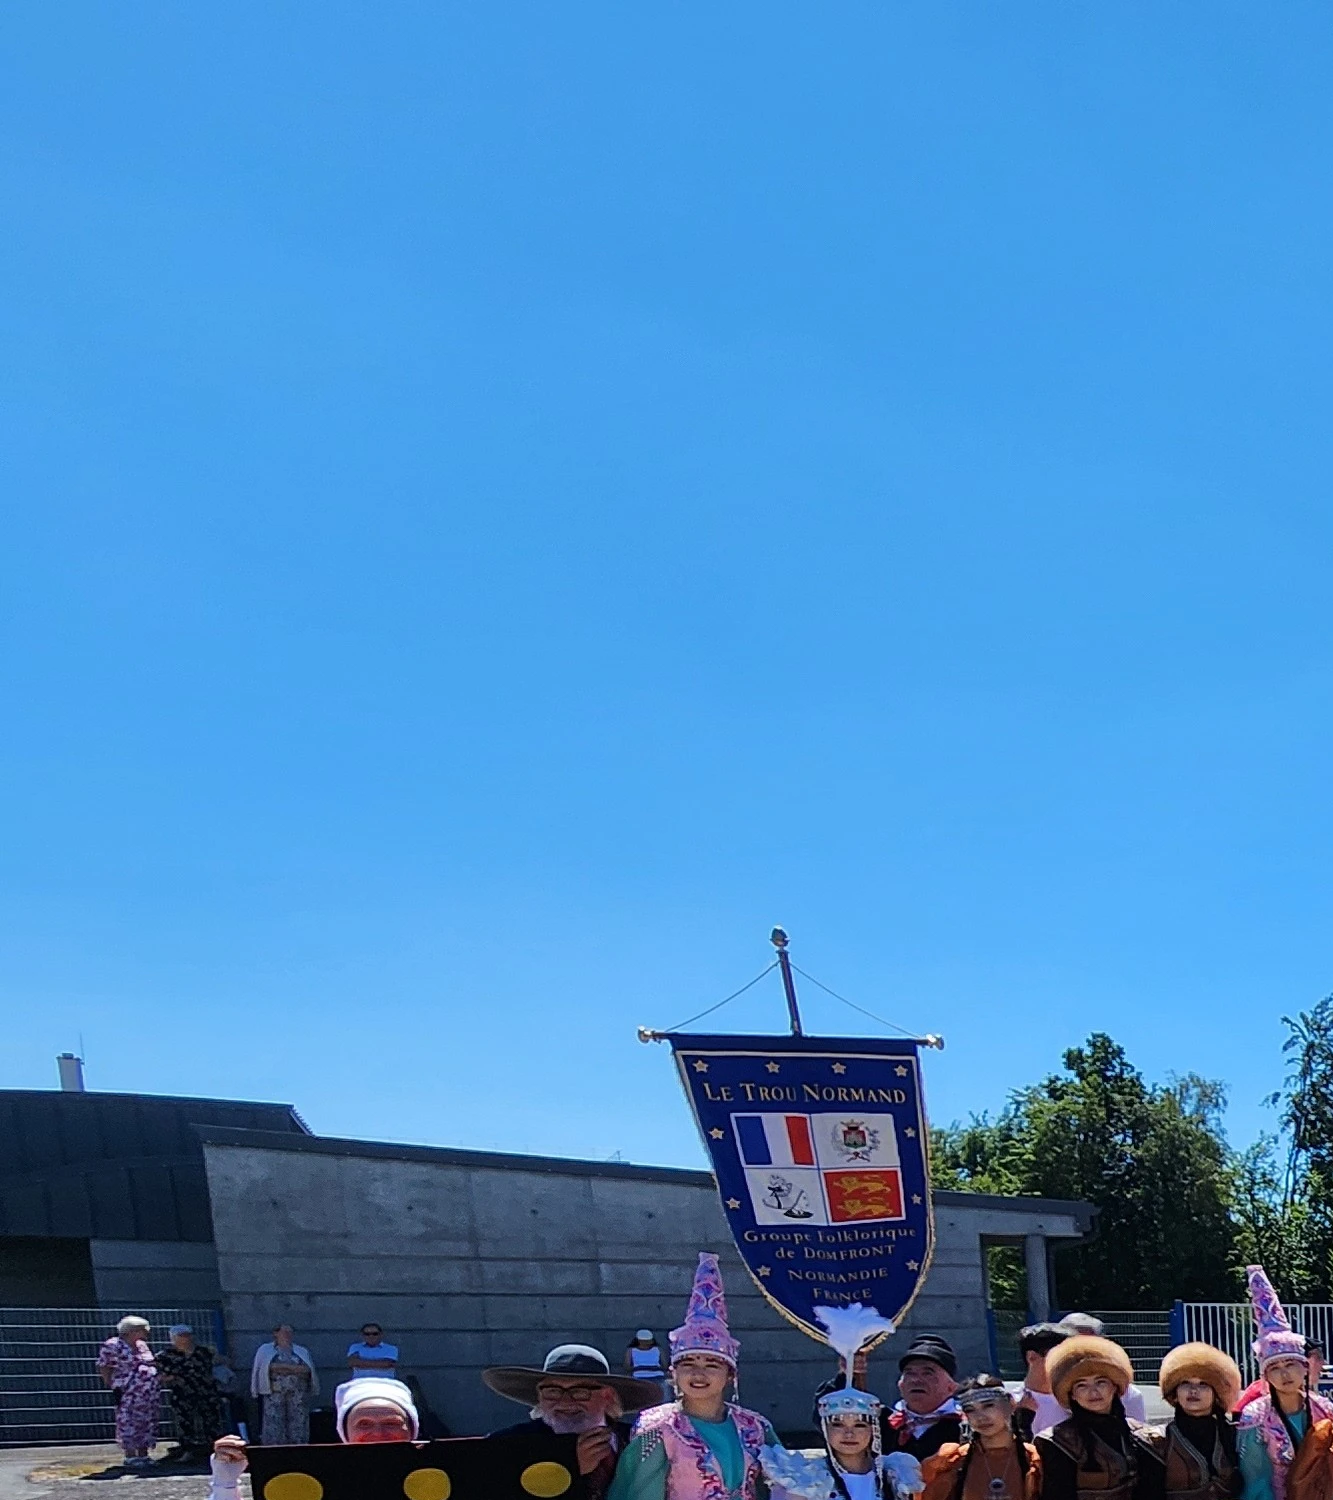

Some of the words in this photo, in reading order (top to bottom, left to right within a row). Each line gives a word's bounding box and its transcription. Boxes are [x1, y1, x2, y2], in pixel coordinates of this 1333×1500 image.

[703, 1082, 734, 1102] LE
[740, 1083, 797, 1103] TROU
[802, 1084, 907, 1104] NORMAND
[743, 1230, 812, 1245] Groupe
[818, 1226, 917, 1244] Folklorique
[775, 1246, 796, 1259] de
[804, 1244, 896, 1262] DOMFRONT
[788, 1267, 889, 1284] NORMANDIE
[813, 1287, 873, 1302] FRANCE
